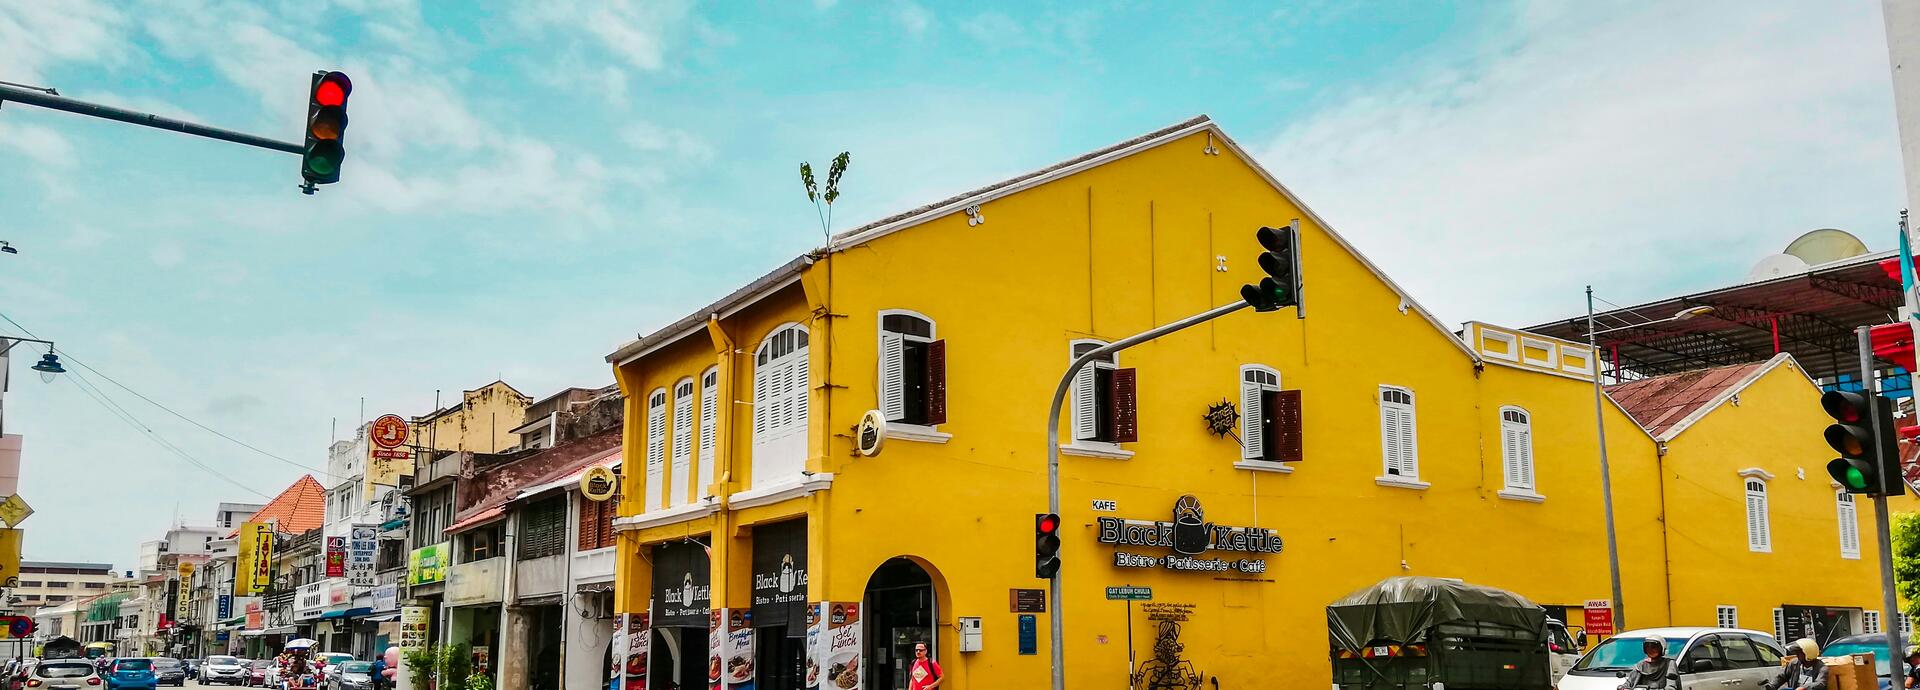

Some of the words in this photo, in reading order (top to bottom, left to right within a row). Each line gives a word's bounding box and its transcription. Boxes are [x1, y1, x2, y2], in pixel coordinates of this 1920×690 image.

[1092, 500, 1116, 511] KAFE
[328, 538, 344, 548] 4D
[1099, 517, 1173, 547] Black
[1216, 526, 1284, 553] Kettle
[1116, 552, 1156, 568] Bistro
[1167, 555, 1228, 572] Patisserie
[1239, 559, 1266, 573] Café
[756, 572, 779, 590] Black
[179, 576, 190, 612] ENRICO
[665, 588, 682, 603] Black
[756, 596, 770, 605] Bistro
[836, 625, 852, 640] Set
[831, 632, 857, 652] Lunch
